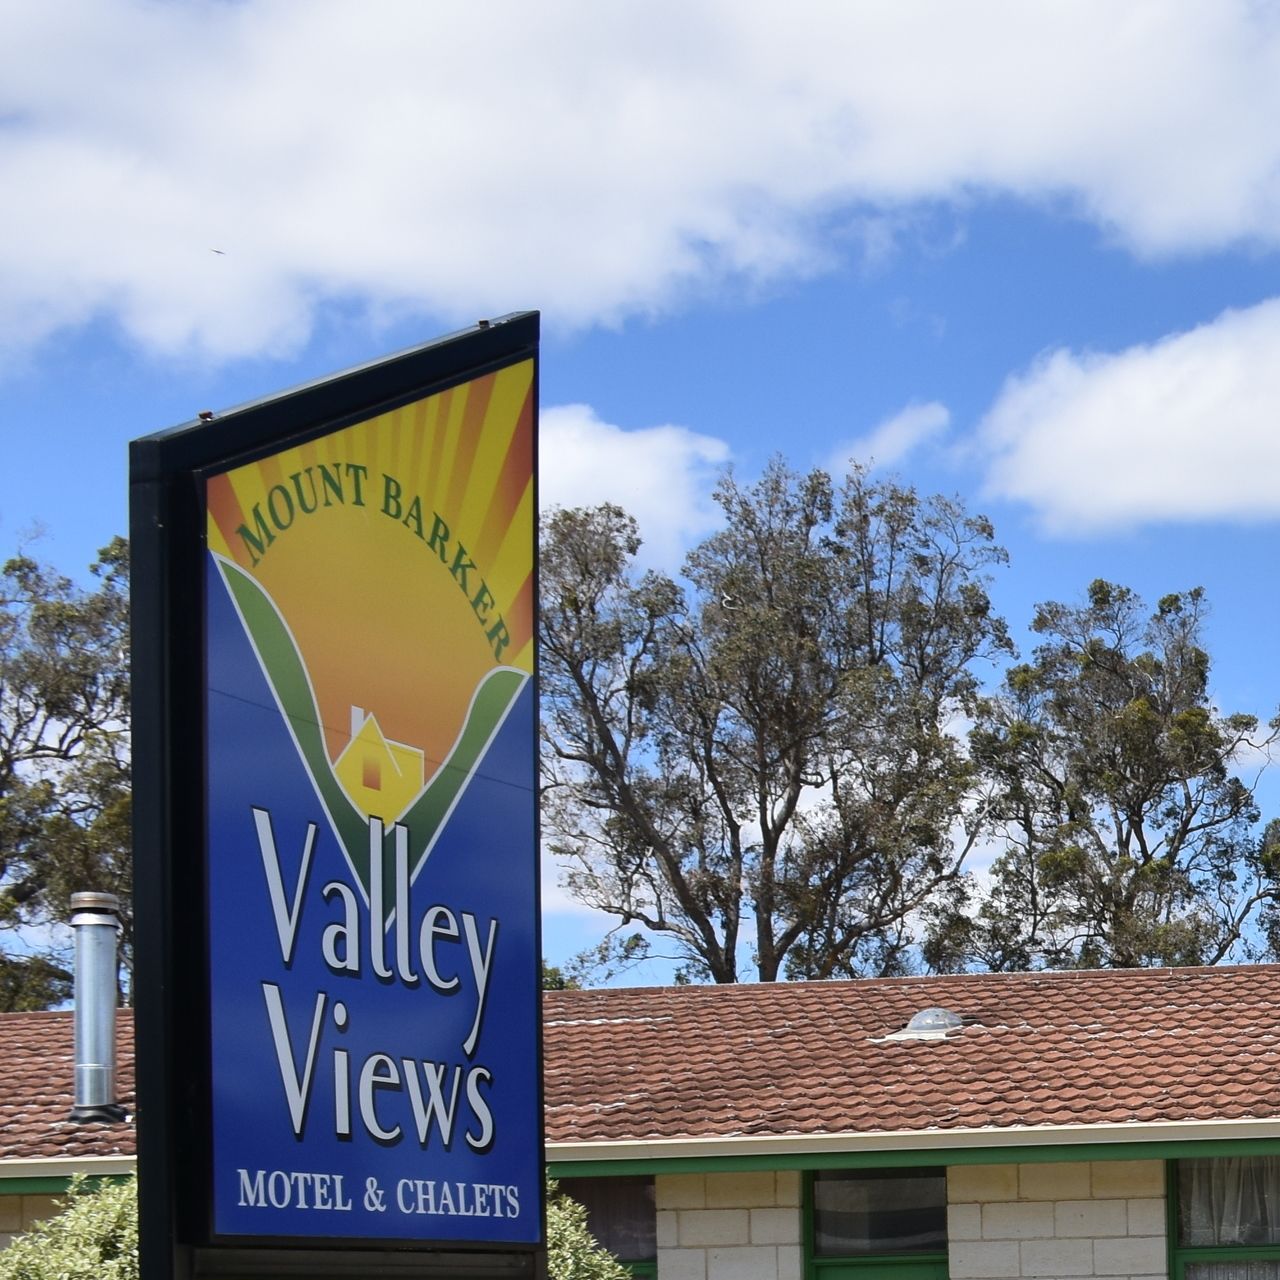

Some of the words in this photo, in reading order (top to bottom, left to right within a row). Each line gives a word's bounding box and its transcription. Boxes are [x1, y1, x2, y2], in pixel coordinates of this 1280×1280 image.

[235, 463, 368, 568] MOUNT
[381, 474, 511, 662] BARKER
[251, 806, 498, 1056] Valley
[262, 982, 494, 1149] Views
[237, 1169, 352, 1212] MOTEL
[363, 1177, 386, 1212] &
[396, 1179, 520, 1219] CHALETS
